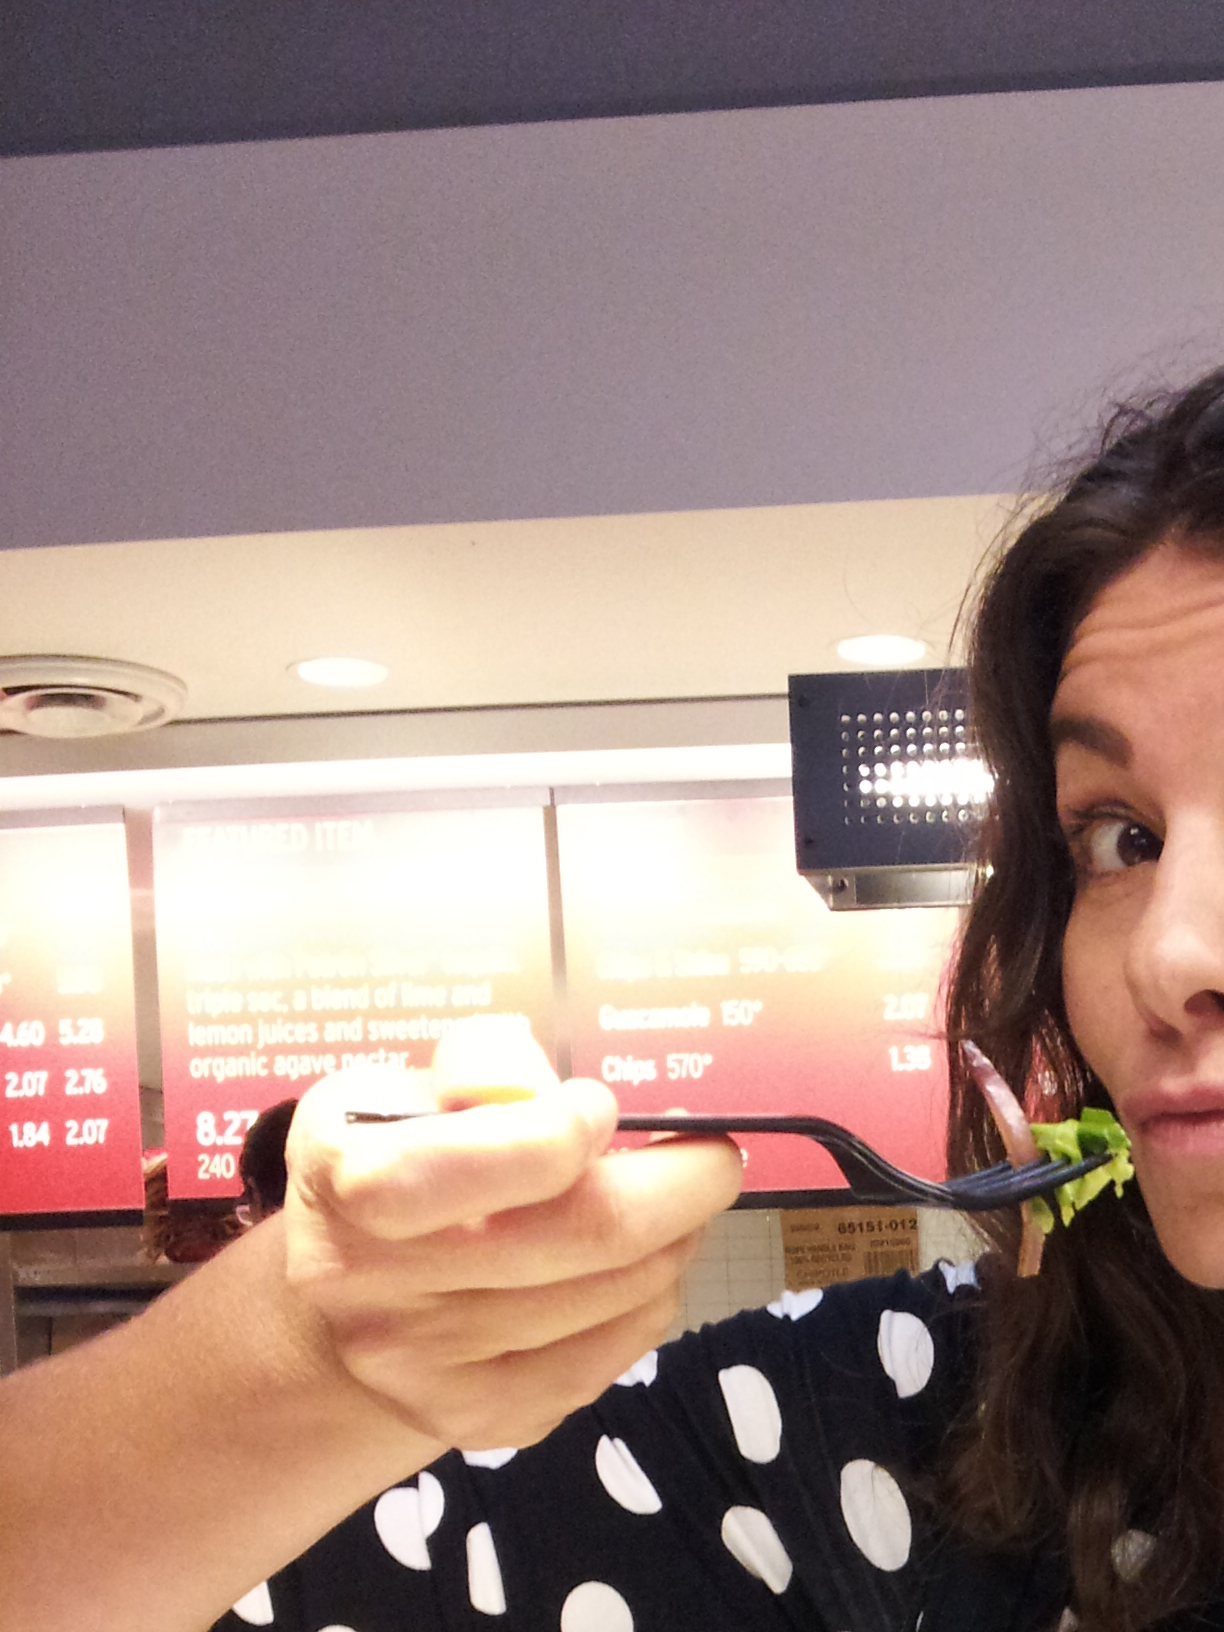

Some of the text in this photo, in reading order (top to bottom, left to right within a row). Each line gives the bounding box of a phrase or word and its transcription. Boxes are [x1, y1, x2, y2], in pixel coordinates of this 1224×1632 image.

[183, 819, 373, 857] FEATURED ITEM
[293, 990, 307, 1011] a
[310, 984, 371, 1010] blend
[373, 981, 398, 1008] of
[401, 981, 448, 1008] lime
[450, 981, 492, 1007] and
[188, 1021, 253, 1047] lemon
[257, 1018, 319, 1050] juices
[323, 1016, 364, 1043] and
[190, 1051, 269, 1083] organic
[273, 1054, 336, 1081] agave
[602, 1055, 657, 1086] Chips
[4, 1068, 108, 1098] 2.07 2.76
[9, 1118, 109, 1148] 1.84 2.07
[198, 1153, 235, 1180] 240
